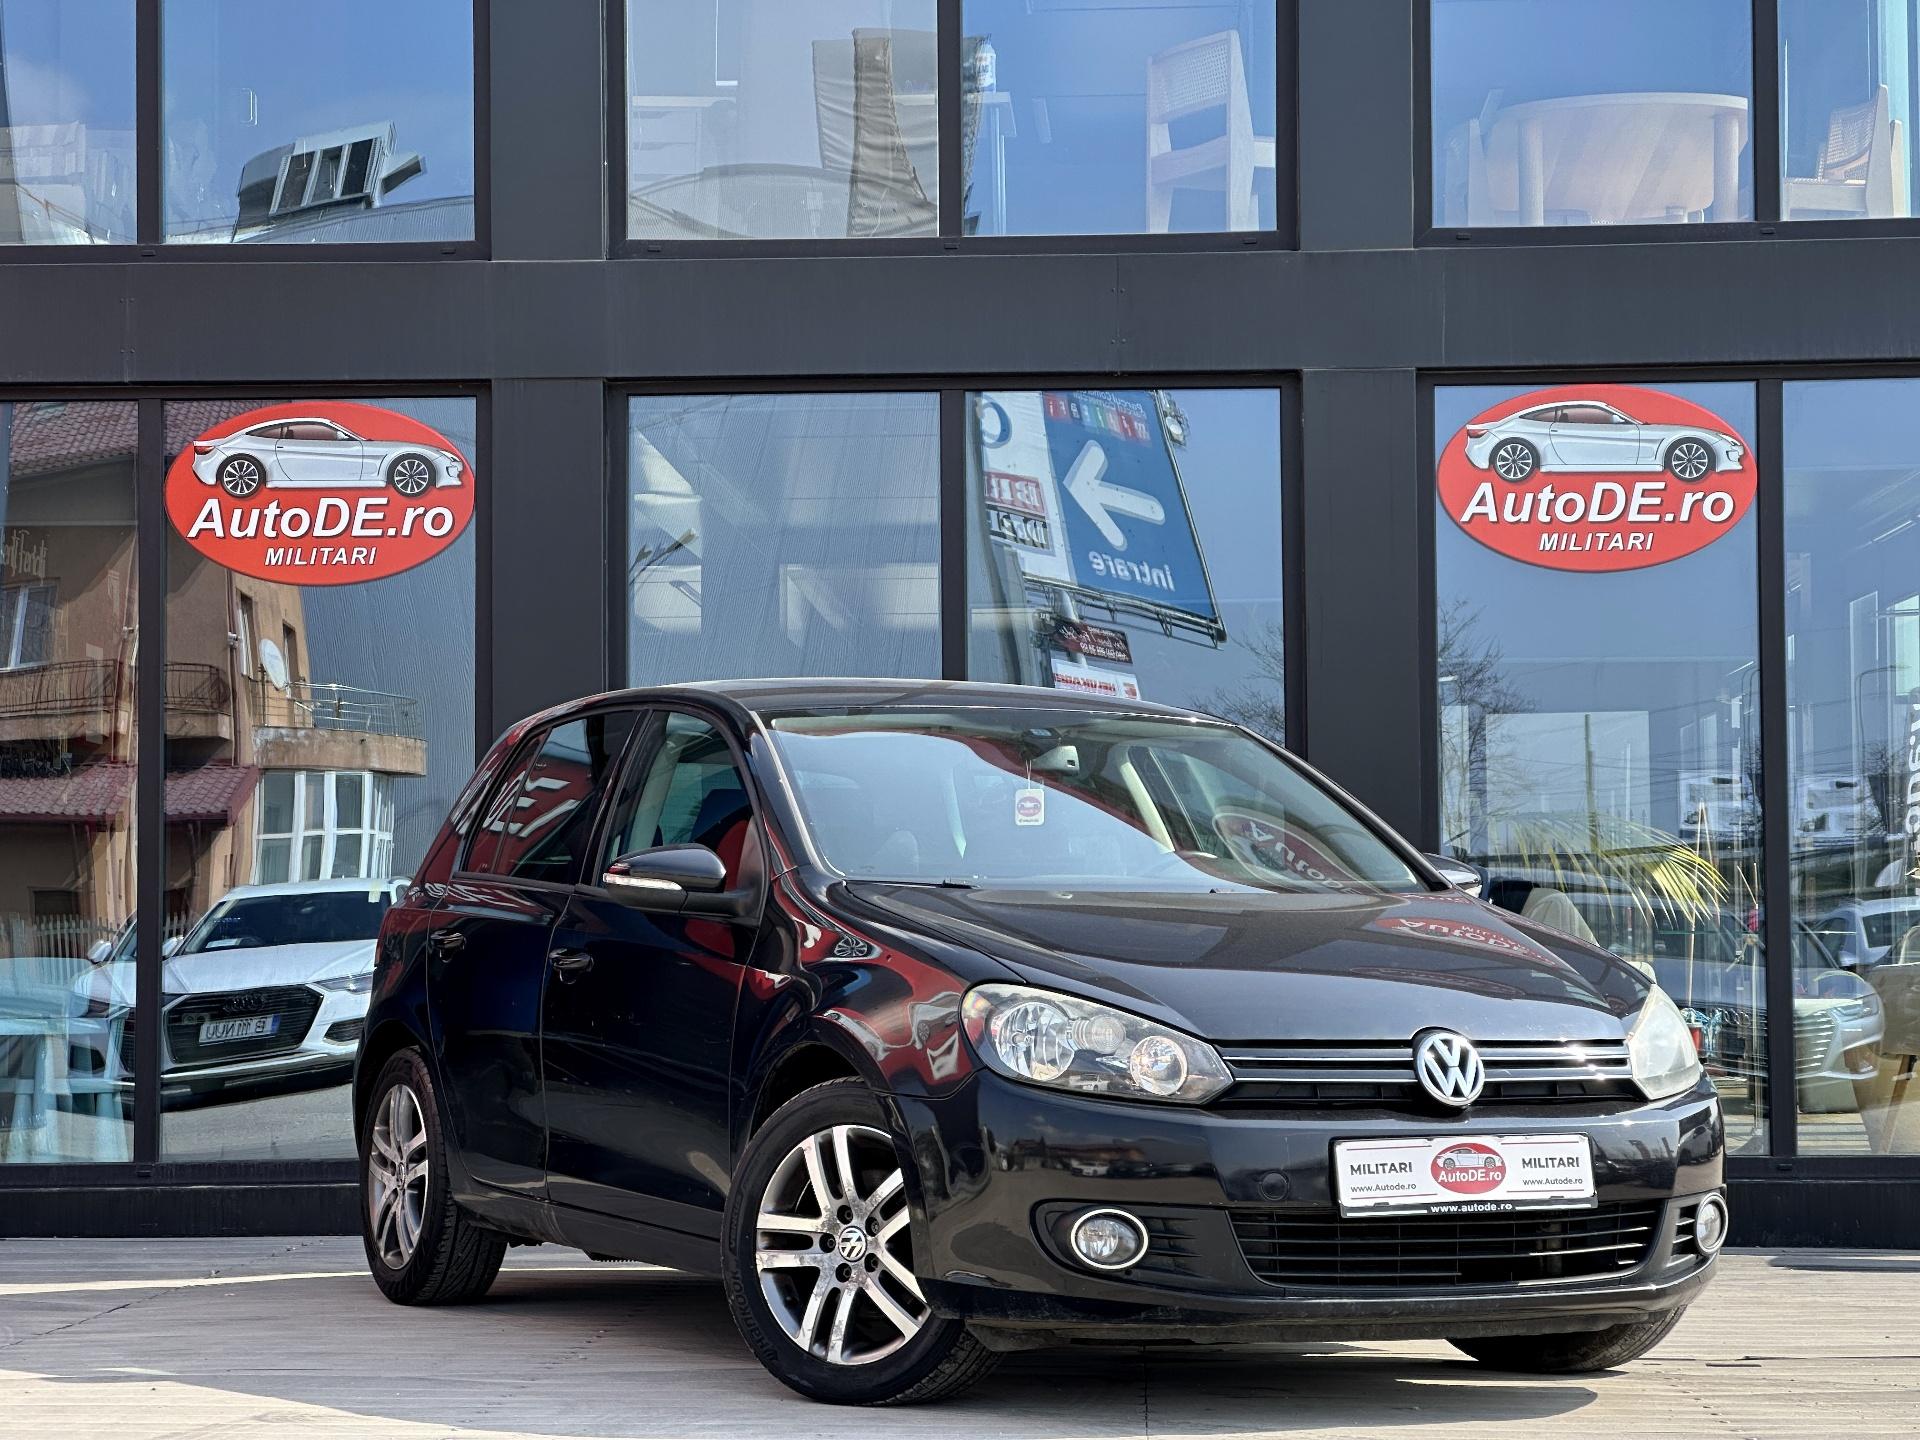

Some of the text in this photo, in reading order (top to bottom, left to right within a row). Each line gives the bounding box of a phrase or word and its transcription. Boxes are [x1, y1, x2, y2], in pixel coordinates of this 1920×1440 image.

[1460, 482, 1735, 524] AutoDE.ro
[187, 497, 455, 541] AutoDE.ro
[1539, 532, 1655, 552] MILITARI
[265, 546, 376, 567] MILITARI
[1350, 1162, 1413, 1176] MILITARI
[1522, 1157, 1580, 1170] MILITARI
[1438, 1168, 1502, 1184] AutoDE.ro
[1522, 1176, 1583, 1187] www.Autode.ro
[1351, 1182, 1417, 1193] www.Autode.ro
[1430, 1201, 1513, 1214] www.autode.ro
